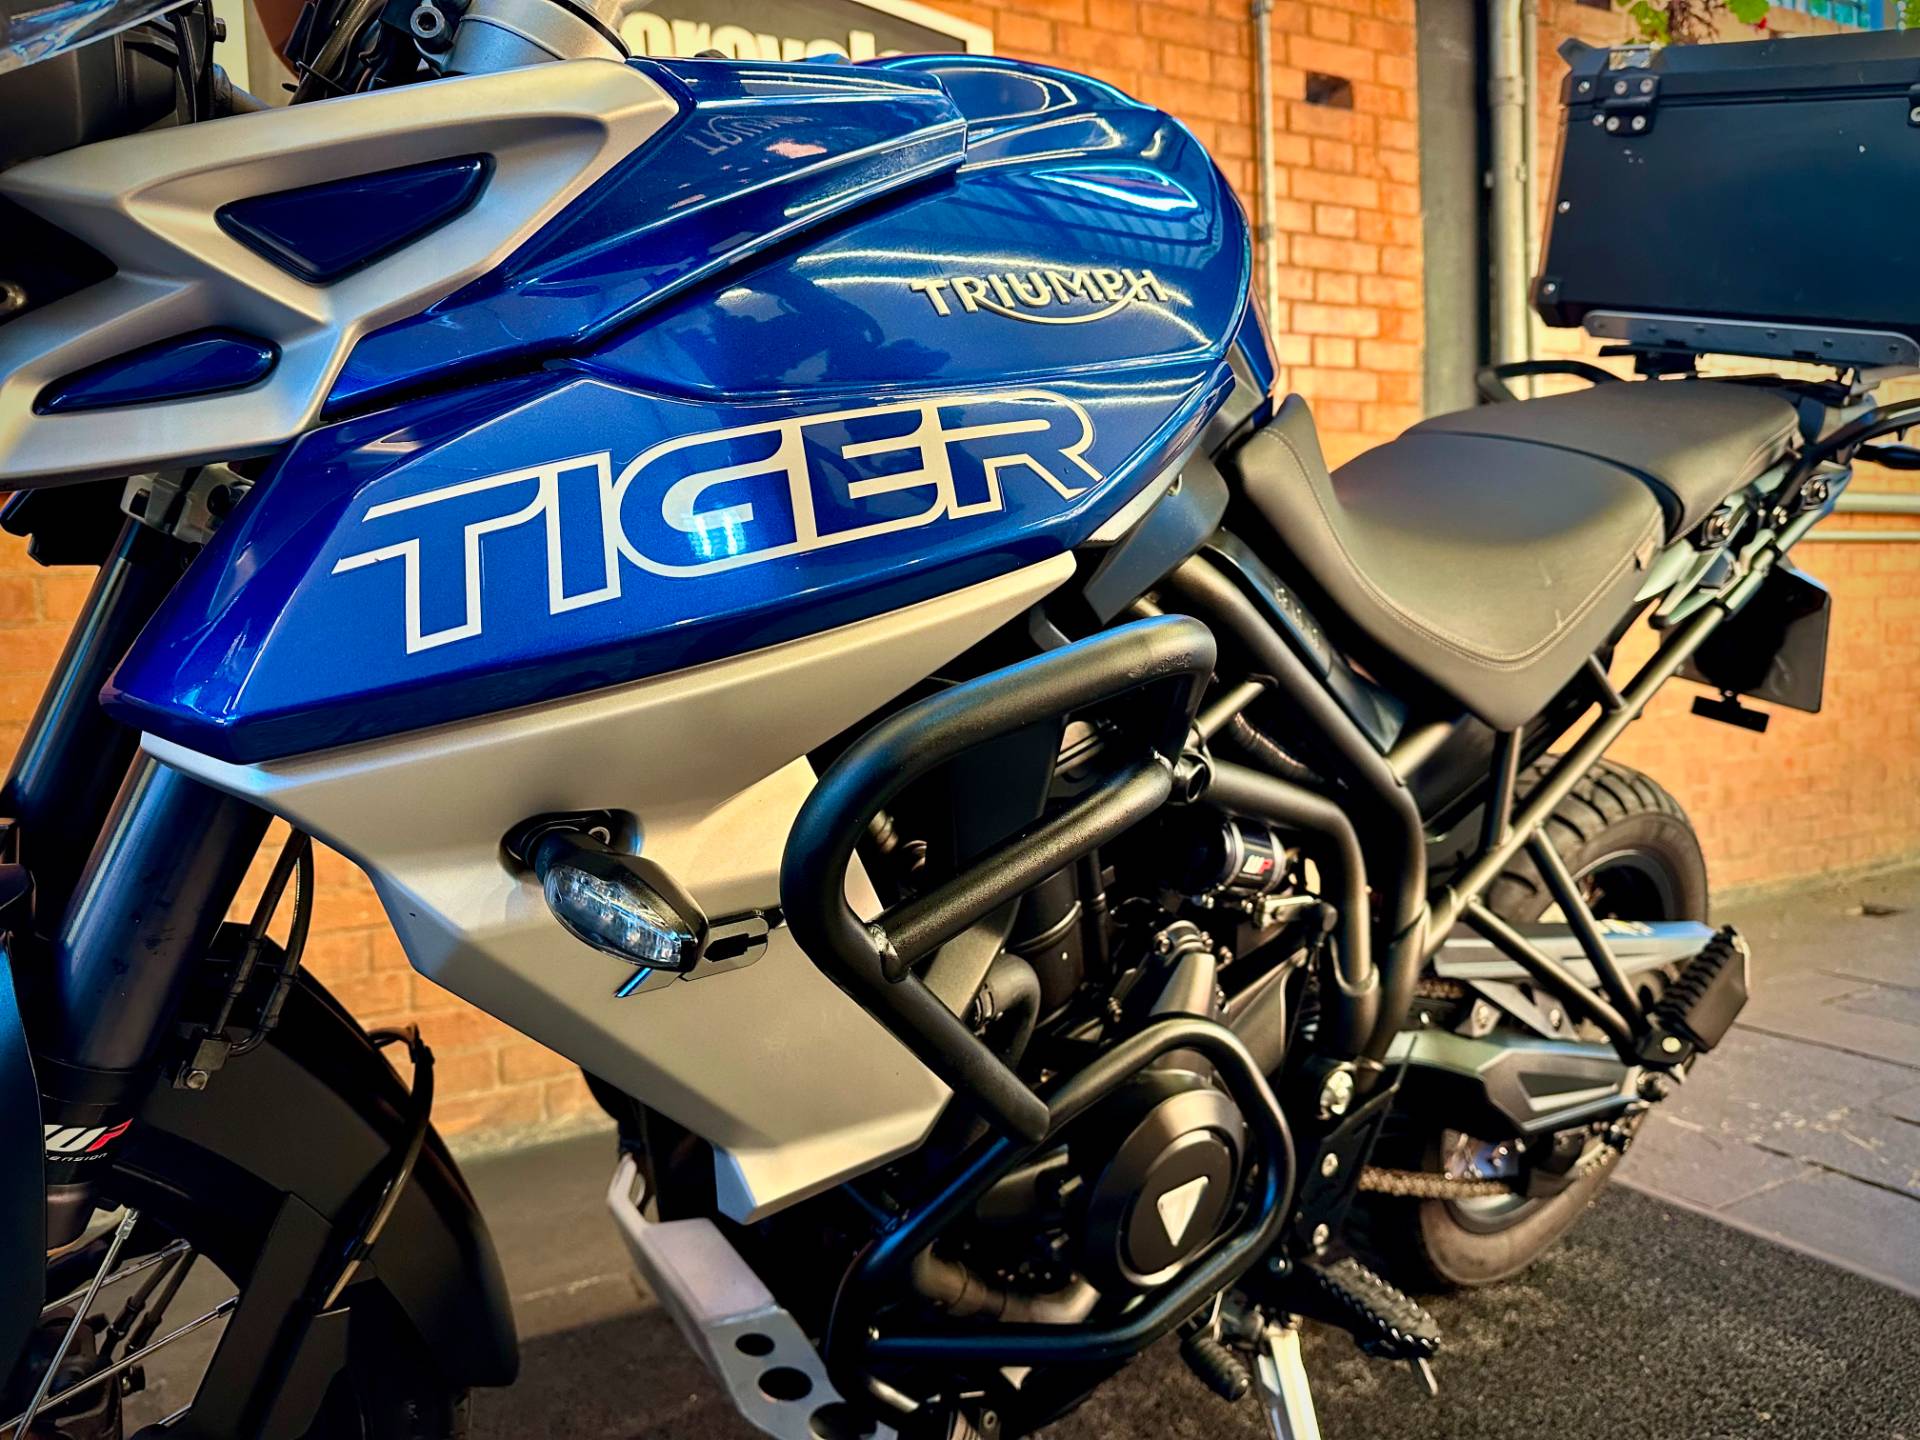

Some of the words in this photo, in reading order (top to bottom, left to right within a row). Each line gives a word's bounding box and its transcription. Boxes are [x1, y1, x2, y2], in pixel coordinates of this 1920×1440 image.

[910, 268, 1169, 324] TRIUMPH
[332, 390, 1103, 654] TIGER
[45, 1152, 108, 1162] ension
